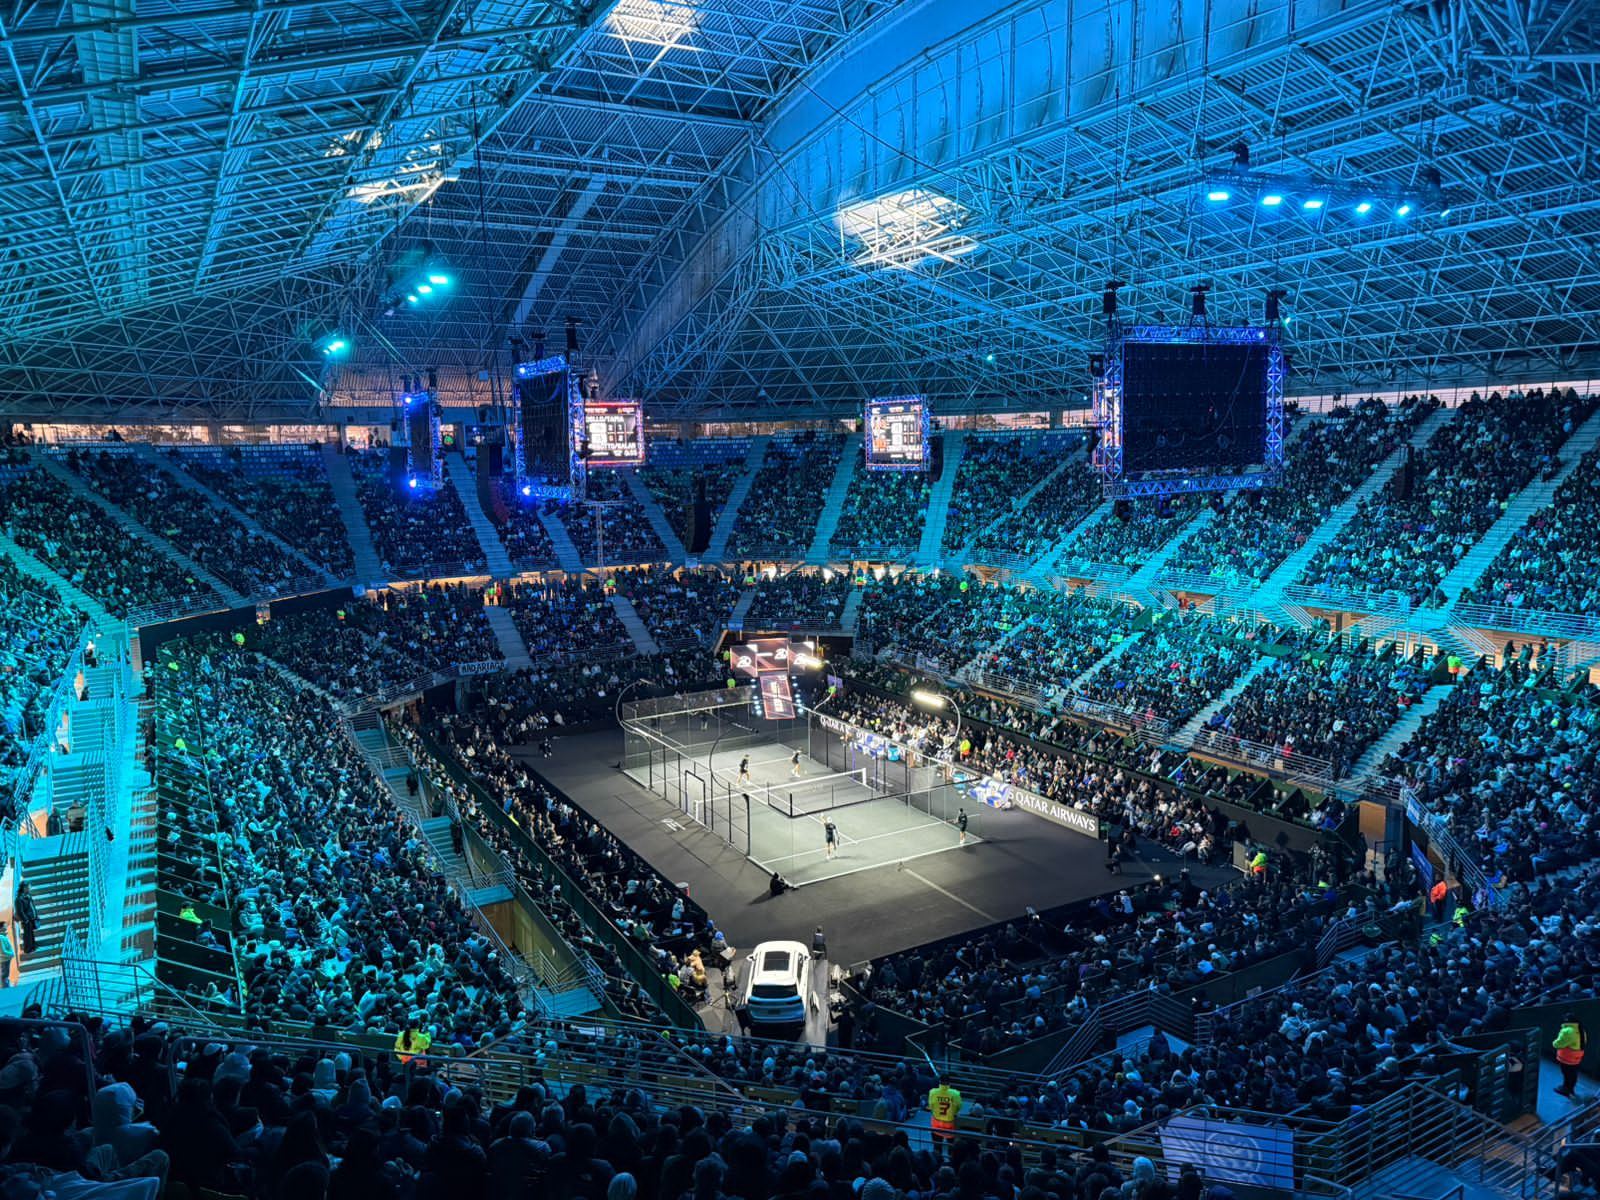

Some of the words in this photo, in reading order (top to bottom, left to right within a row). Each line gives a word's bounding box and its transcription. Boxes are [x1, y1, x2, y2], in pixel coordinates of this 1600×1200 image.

[737, 655, 752, 668] 20
[1015, 791, 1048, 814] QATAR
[1049, 805, 1096, 832] AIRWAYS
